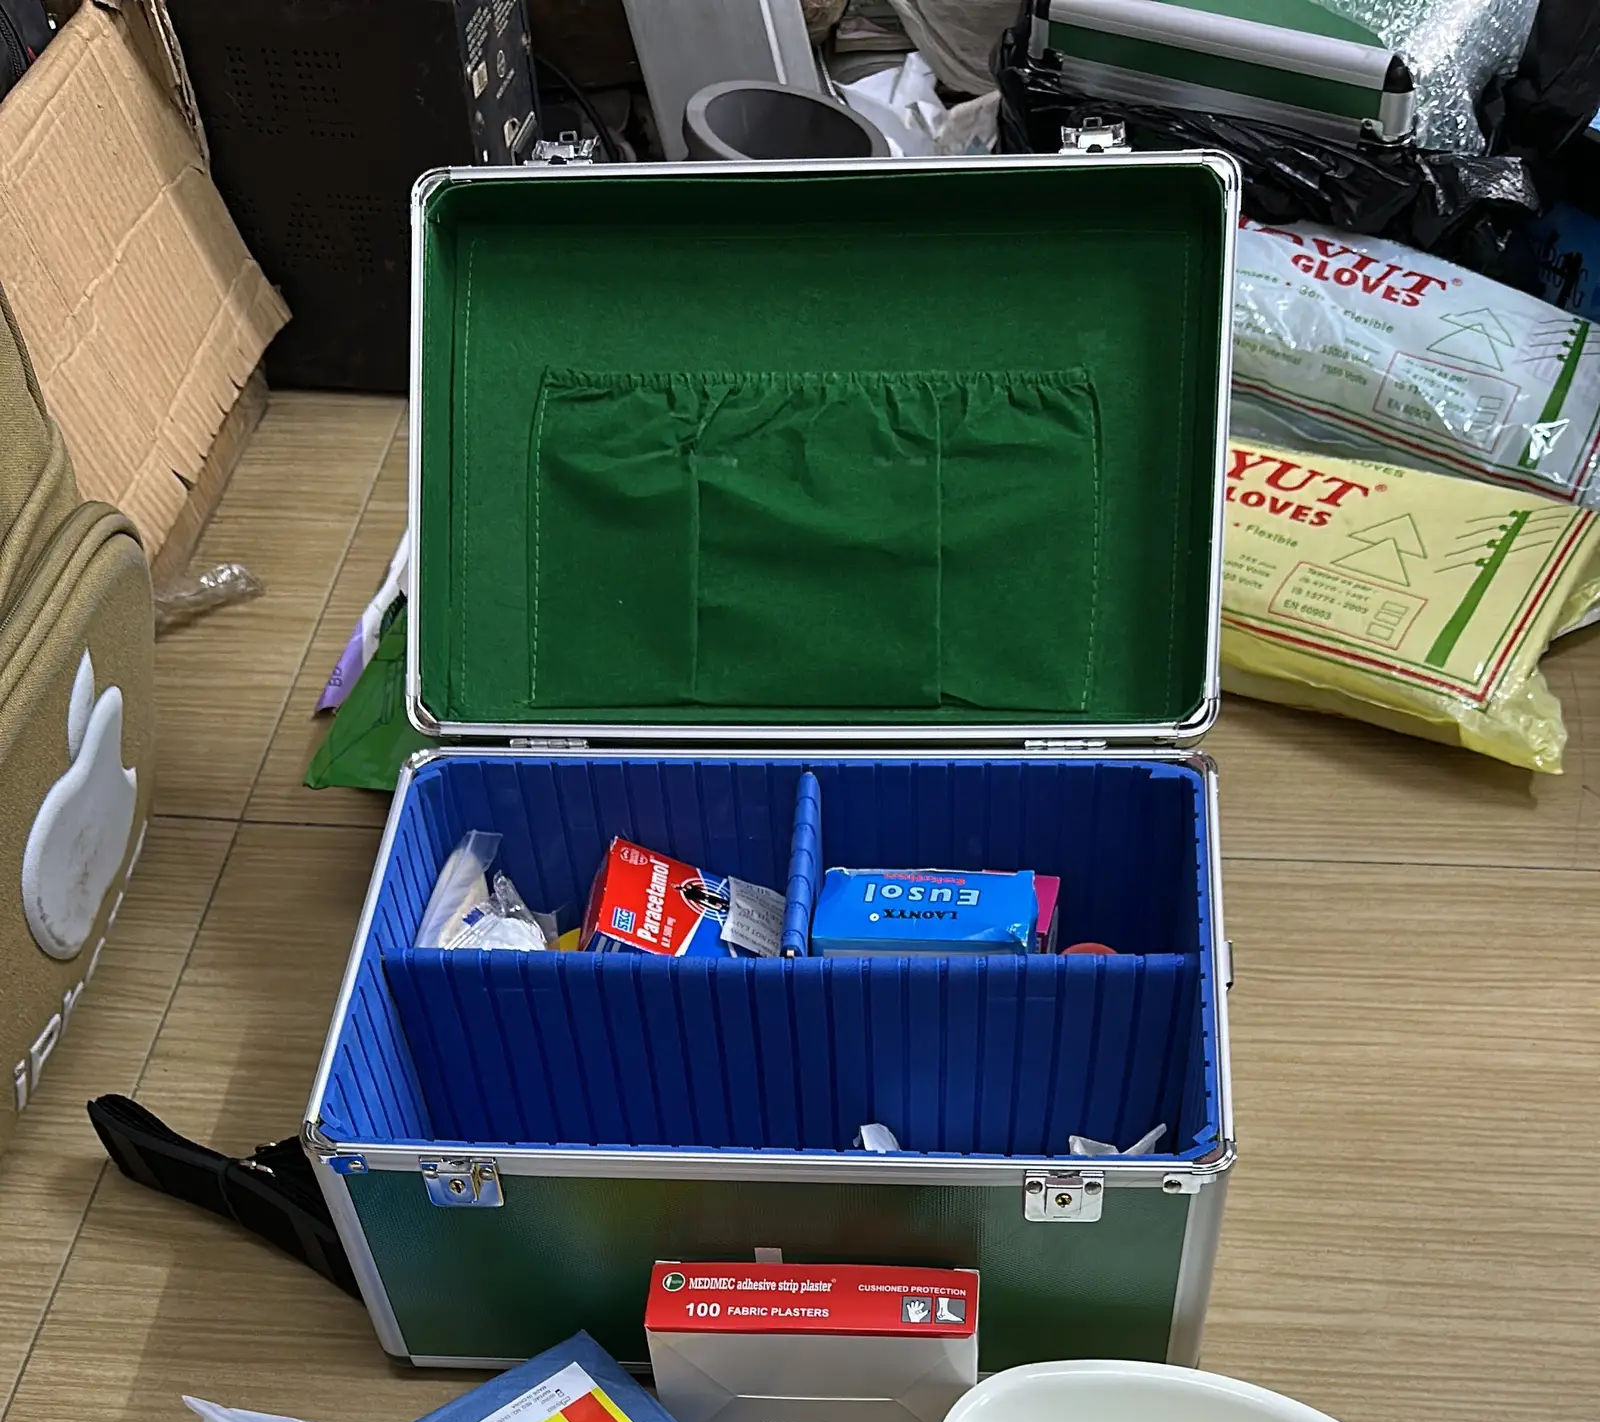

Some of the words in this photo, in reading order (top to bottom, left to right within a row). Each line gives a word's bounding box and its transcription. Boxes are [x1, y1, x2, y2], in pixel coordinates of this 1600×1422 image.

[1291, 254, 1420, 307] GLOVES
[1227, 449, 1370, 507] YUT
[1245, 523, 1299, 549] Flexible
[1284, 599, 1299, 610] EN
[636, 858, 670, 943] Paracetamol
[863, 882, 980, 907] Eusol
[883, 908, 958, 921] LAONYX
[688, 1277, 736, 1290] MEDIMEC
[736, 1278, 776, 1290] adhesive
[778, 1279, 799, 1293] strip
[800, 1279, 832, 1294] plaster
[858, 1283, 909, 1293] CUSHIONED
[910, 1285, 966, 1296] PROTECTION
[685, 1302, 721, 1318] 100
[727, 1306, 768, 1317] FABRIC
[770, 1307, 830, 1318] PLASTERS
